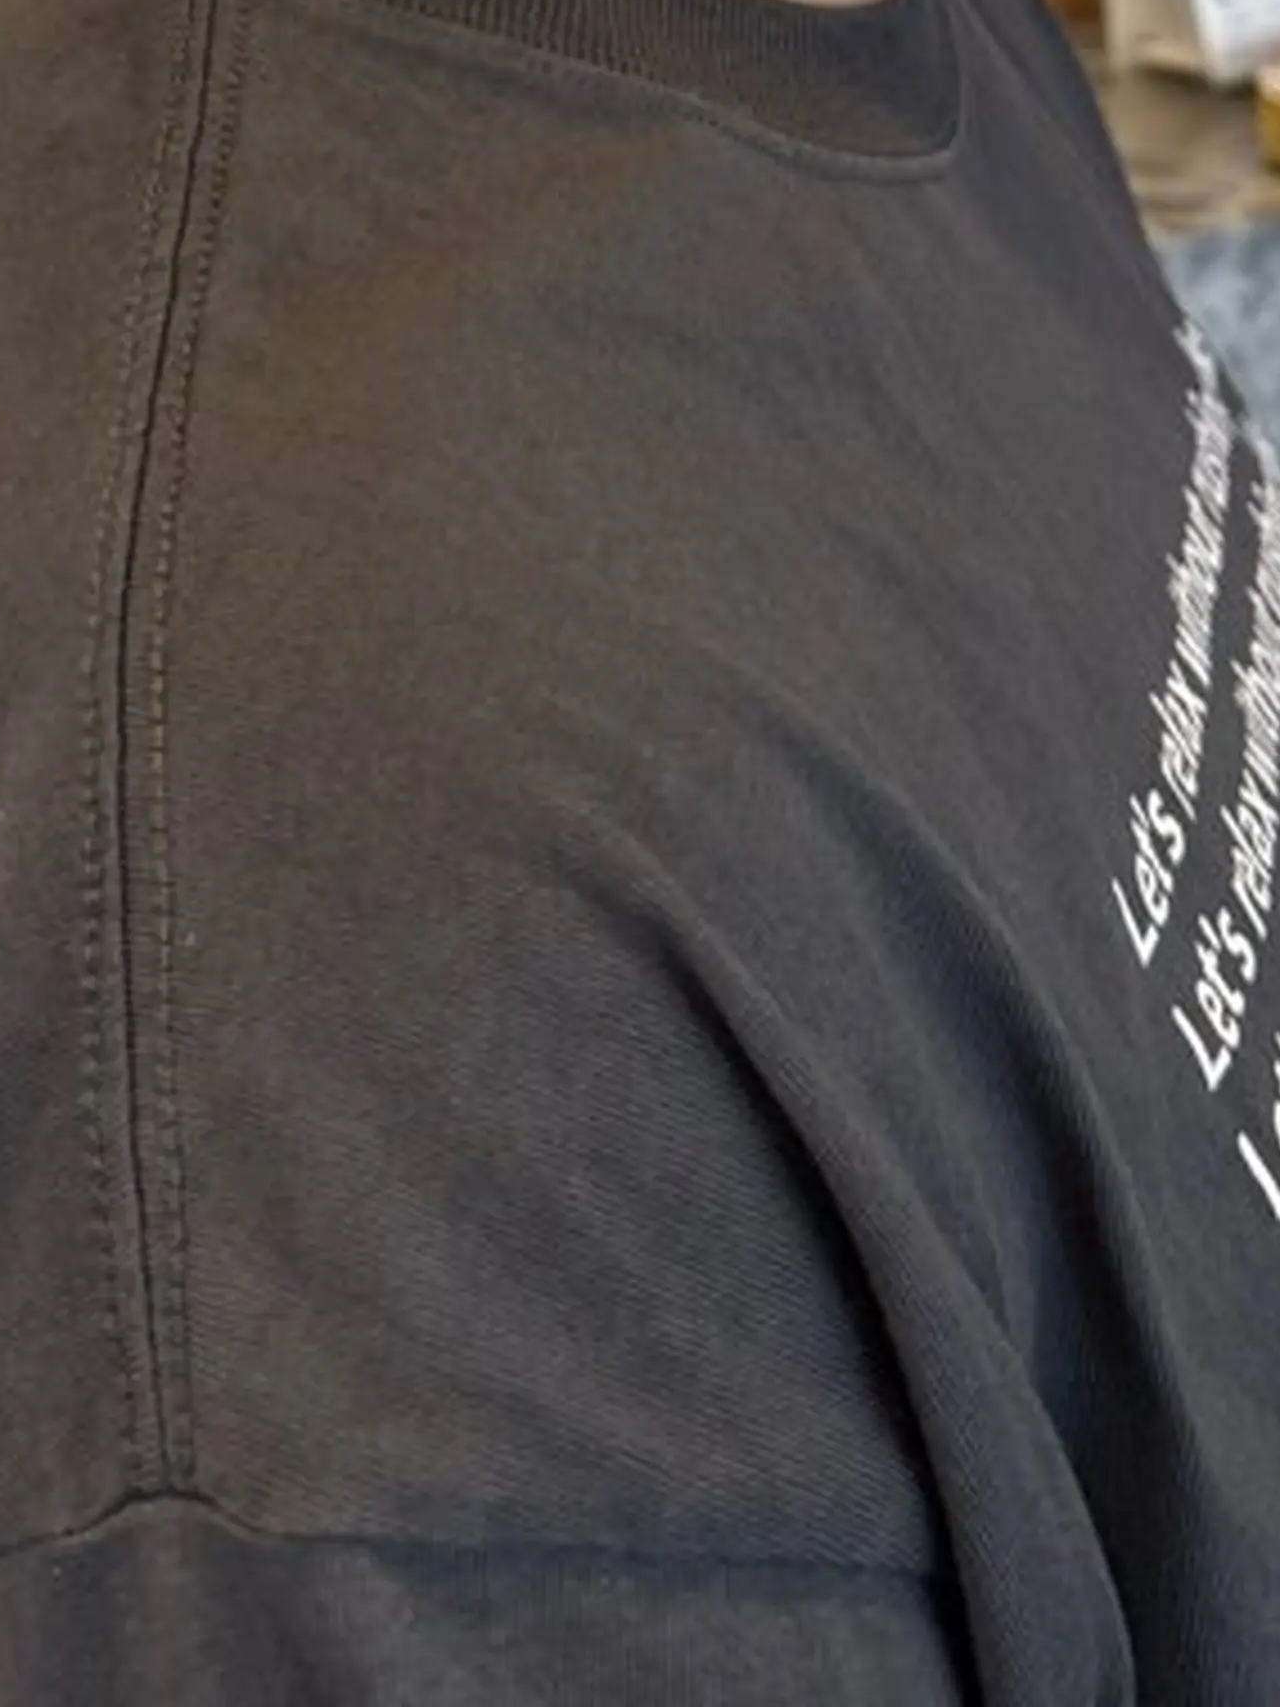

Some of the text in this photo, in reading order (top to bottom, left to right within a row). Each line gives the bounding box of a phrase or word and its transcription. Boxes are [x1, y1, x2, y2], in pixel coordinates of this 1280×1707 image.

[1112, 788, 1186, 966] Let's
[1149, 658, 1208, 821] relax
[1172, 905, 1257, 1092] Let's
[1221, 769, 1280, 940] relax
